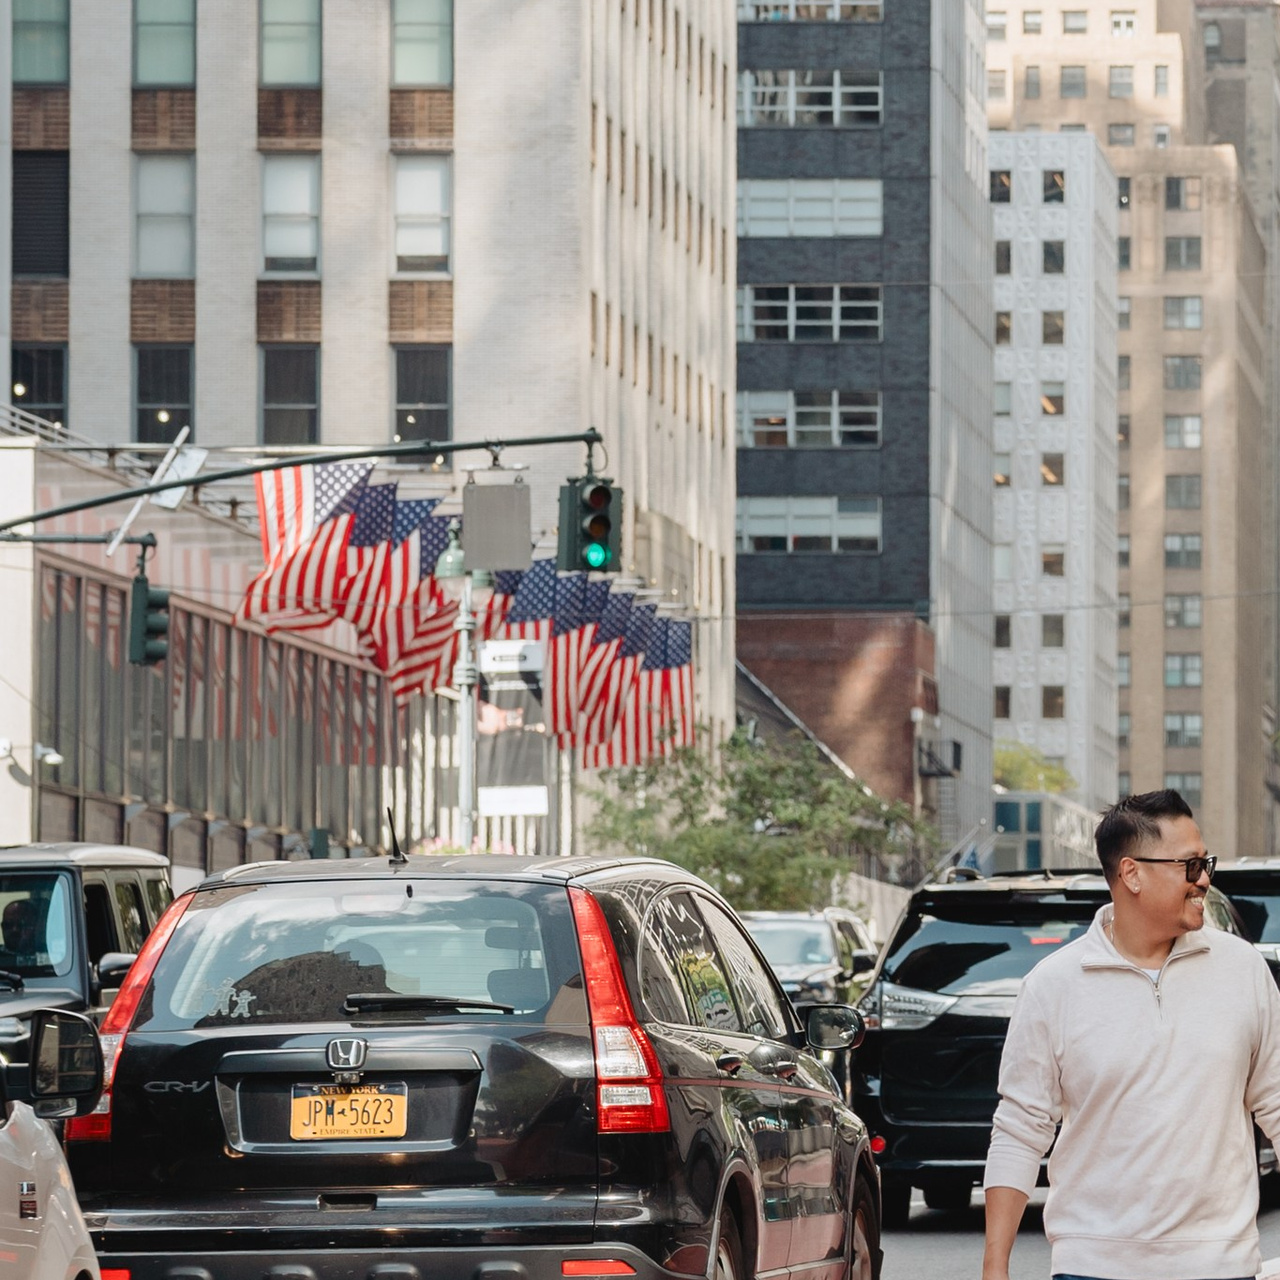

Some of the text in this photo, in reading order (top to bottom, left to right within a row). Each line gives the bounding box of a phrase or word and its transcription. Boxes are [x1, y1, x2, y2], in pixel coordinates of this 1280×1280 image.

[320, 1085, 379, 1095] NEW YORK
[319, 1127, 378, 1135] EMPIRE STATE
